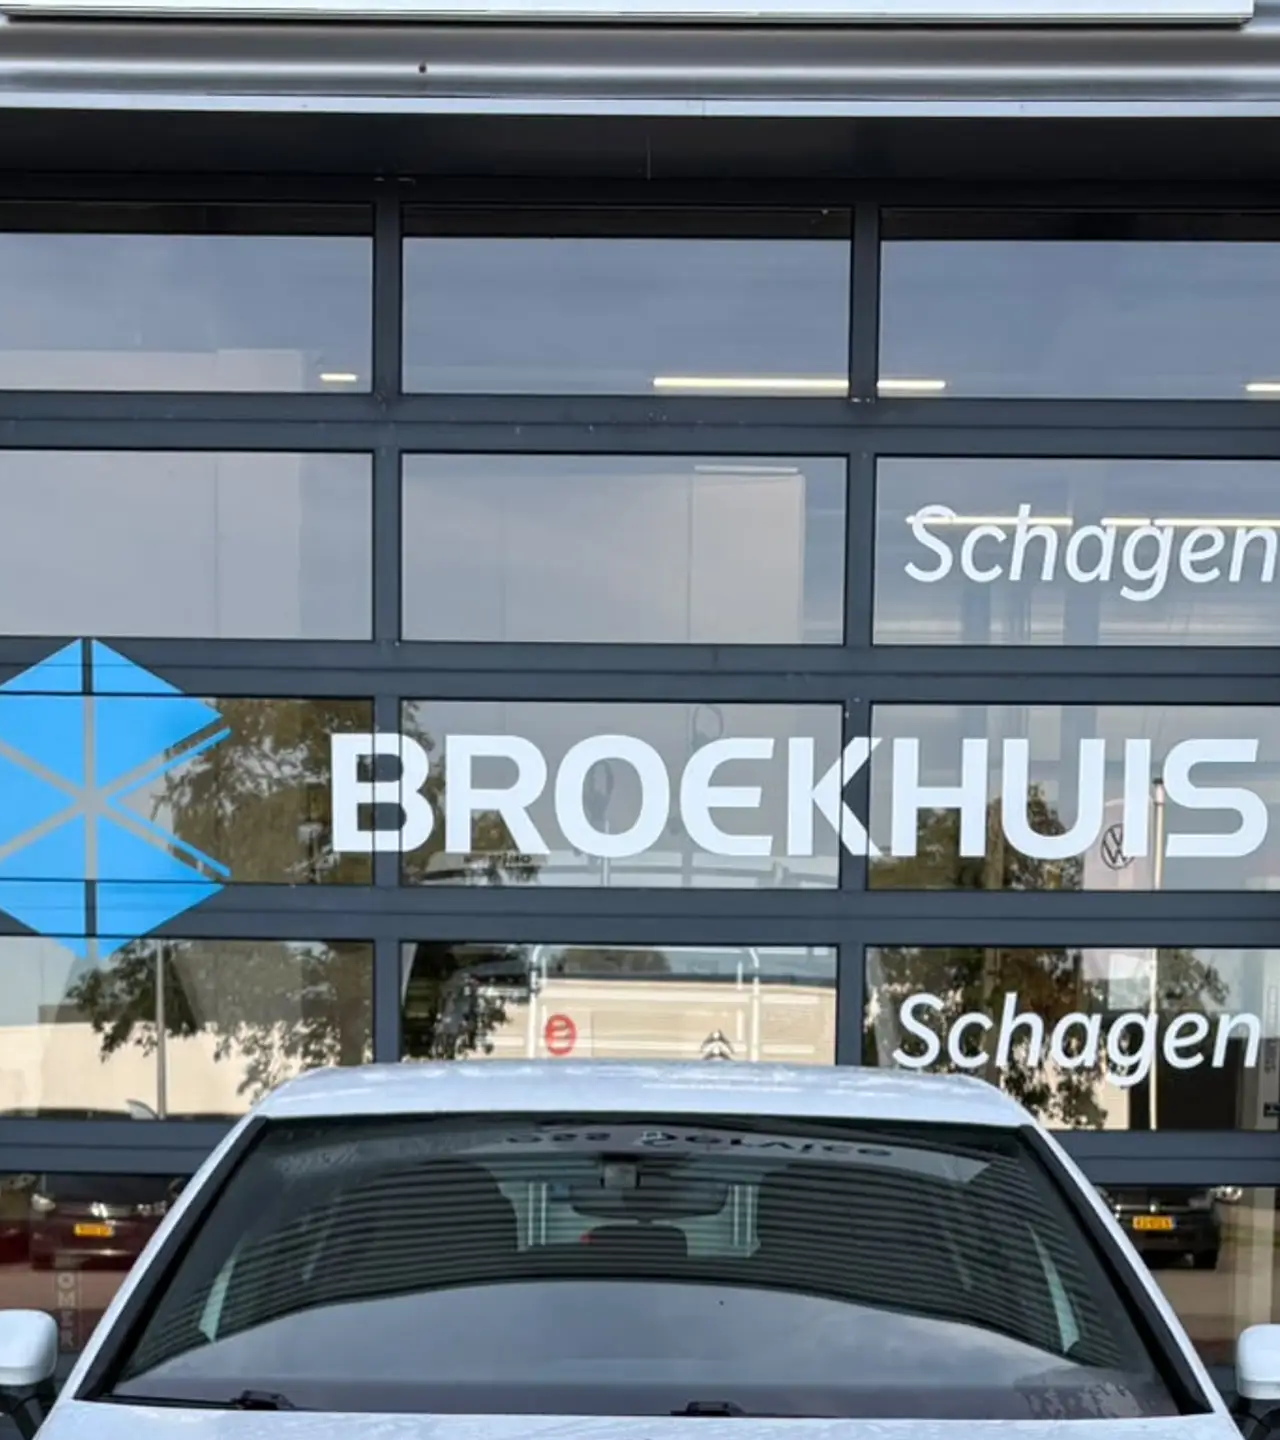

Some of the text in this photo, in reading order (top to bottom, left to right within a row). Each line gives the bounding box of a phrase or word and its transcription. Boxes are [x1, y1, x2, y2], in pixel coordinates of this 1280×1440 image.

[904, 503, 1279, 602] Schagen
[330, 732, 1269, 860] BROEKHUIS
[892, 990, 1262, 1087] Schagen
